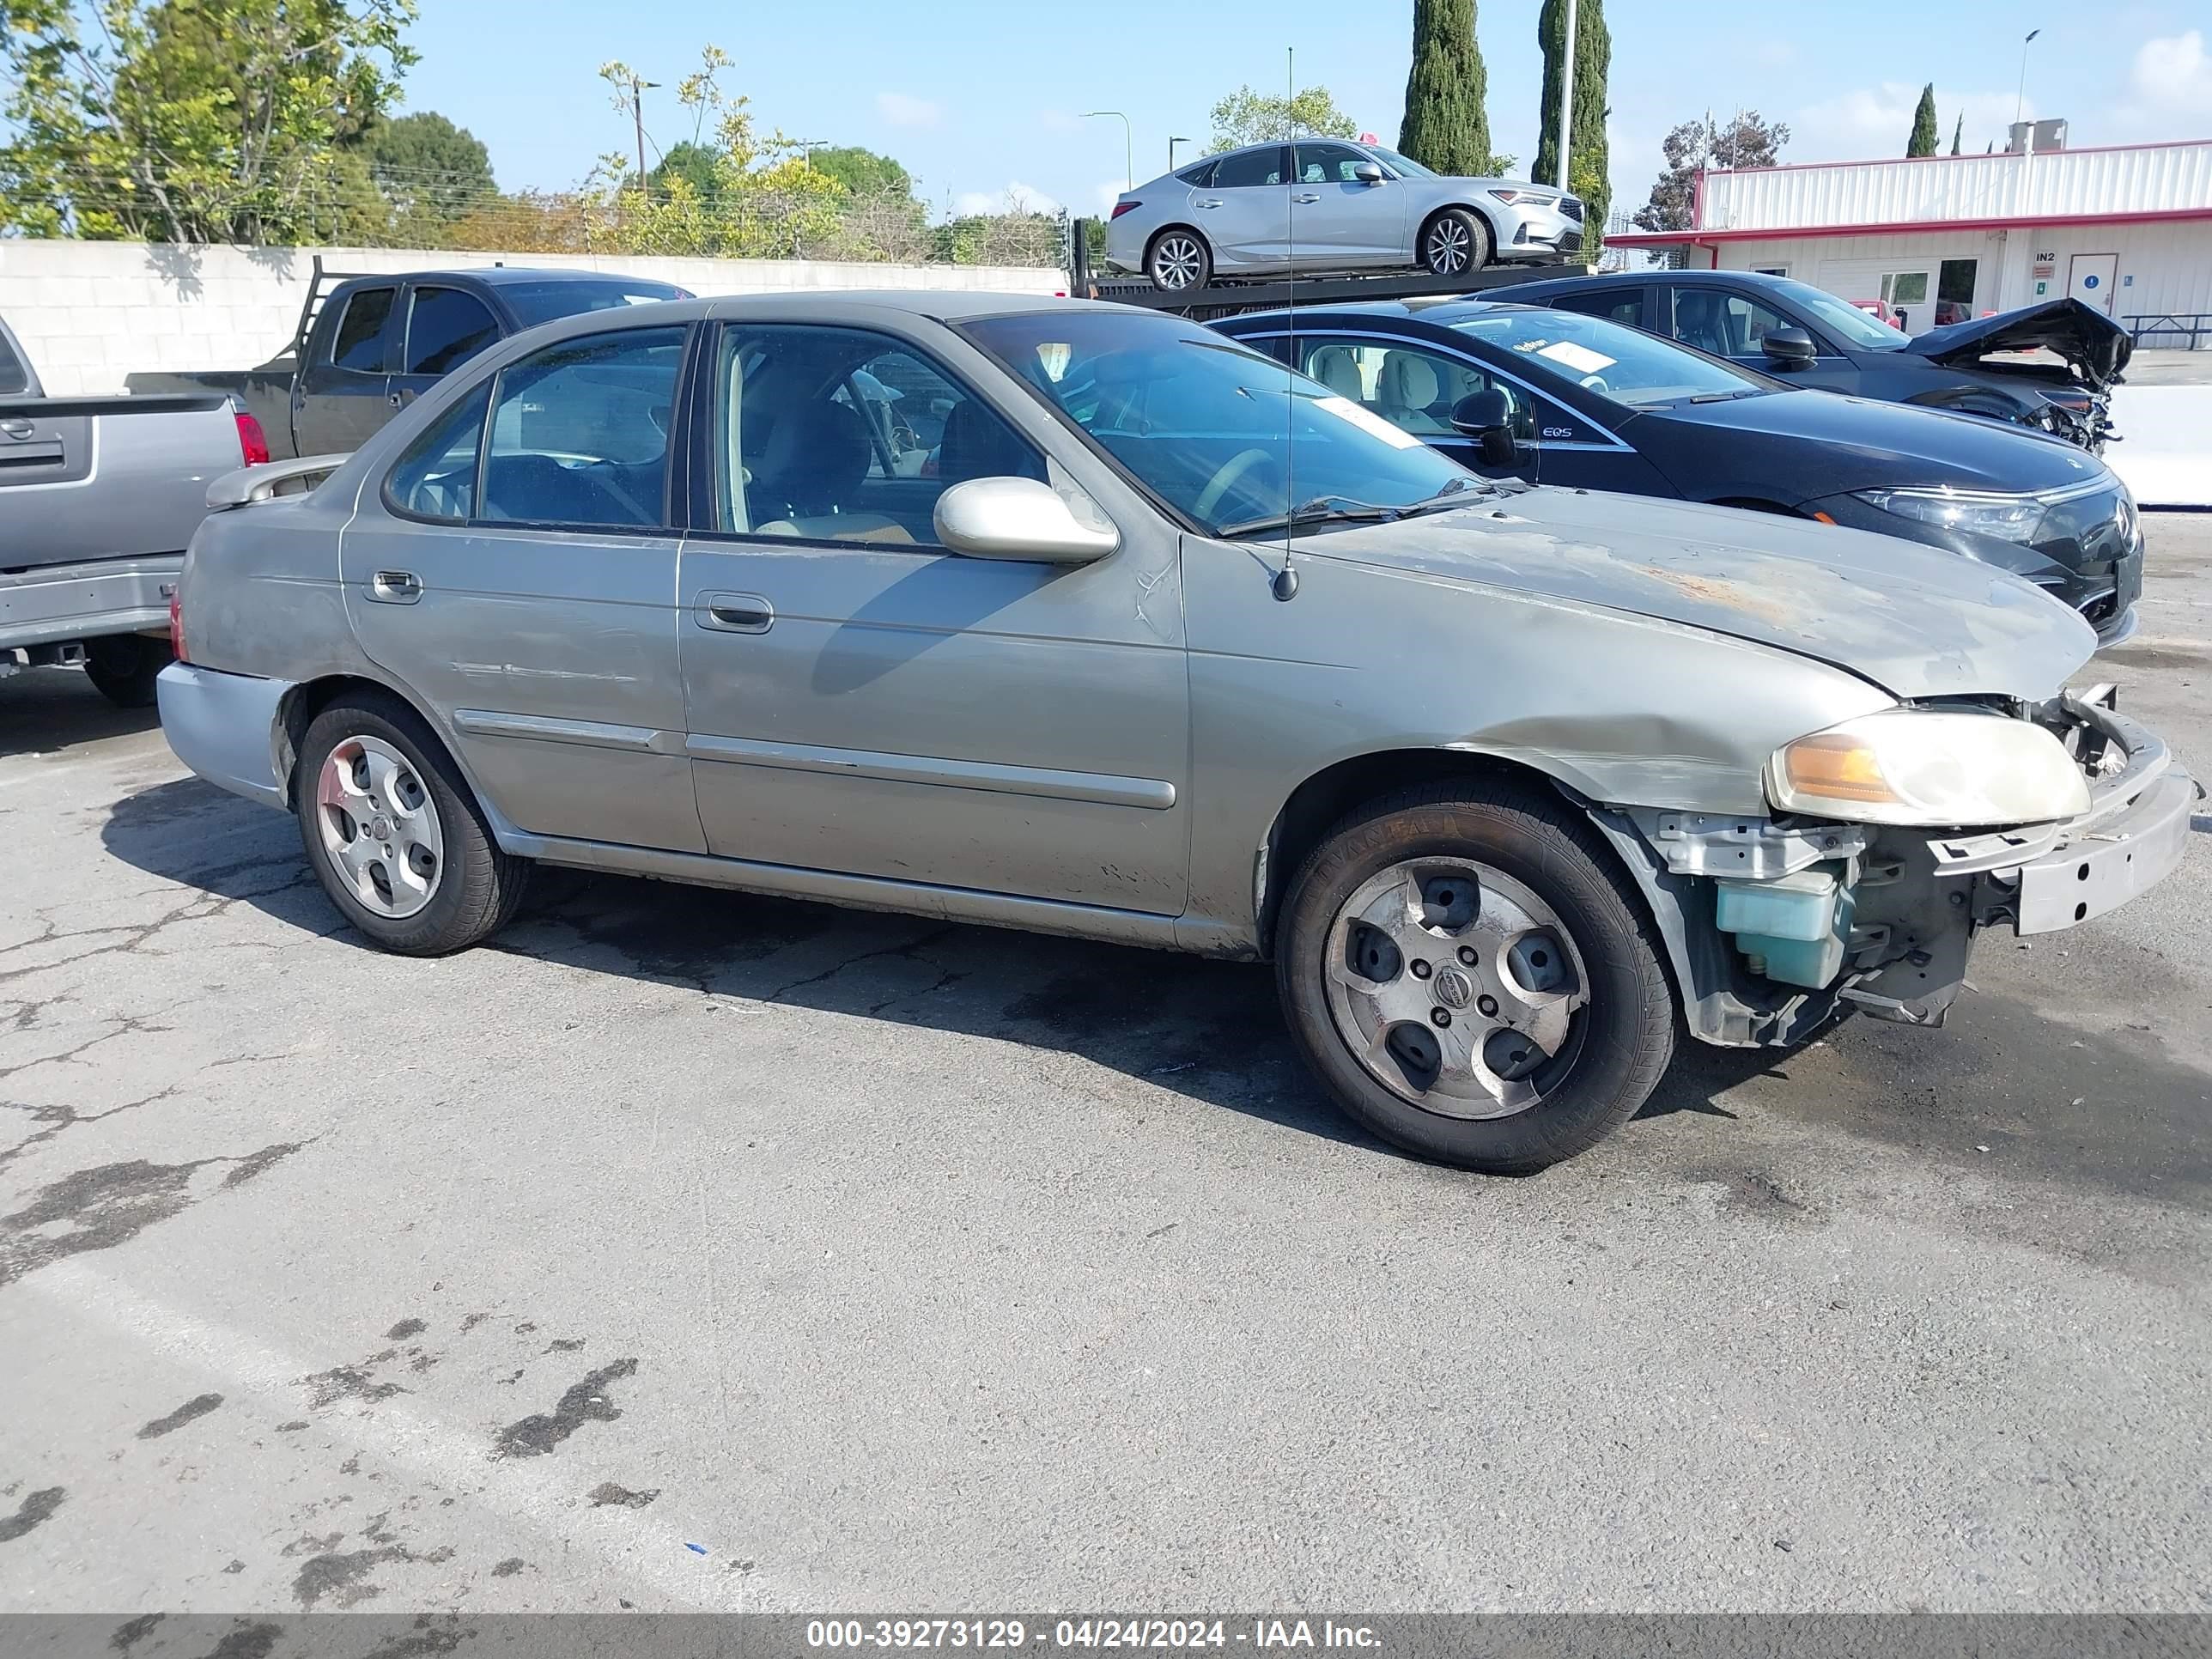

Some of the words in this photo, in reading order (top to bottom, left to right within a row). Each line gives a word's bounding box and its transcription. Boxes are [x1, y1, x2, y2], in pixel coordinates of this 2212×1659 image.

[2036, 252, 2055, 262] IN2
[1543, 427, 1572, 437] EQS
[1444, 970, 1463, 1006] NISSAN
